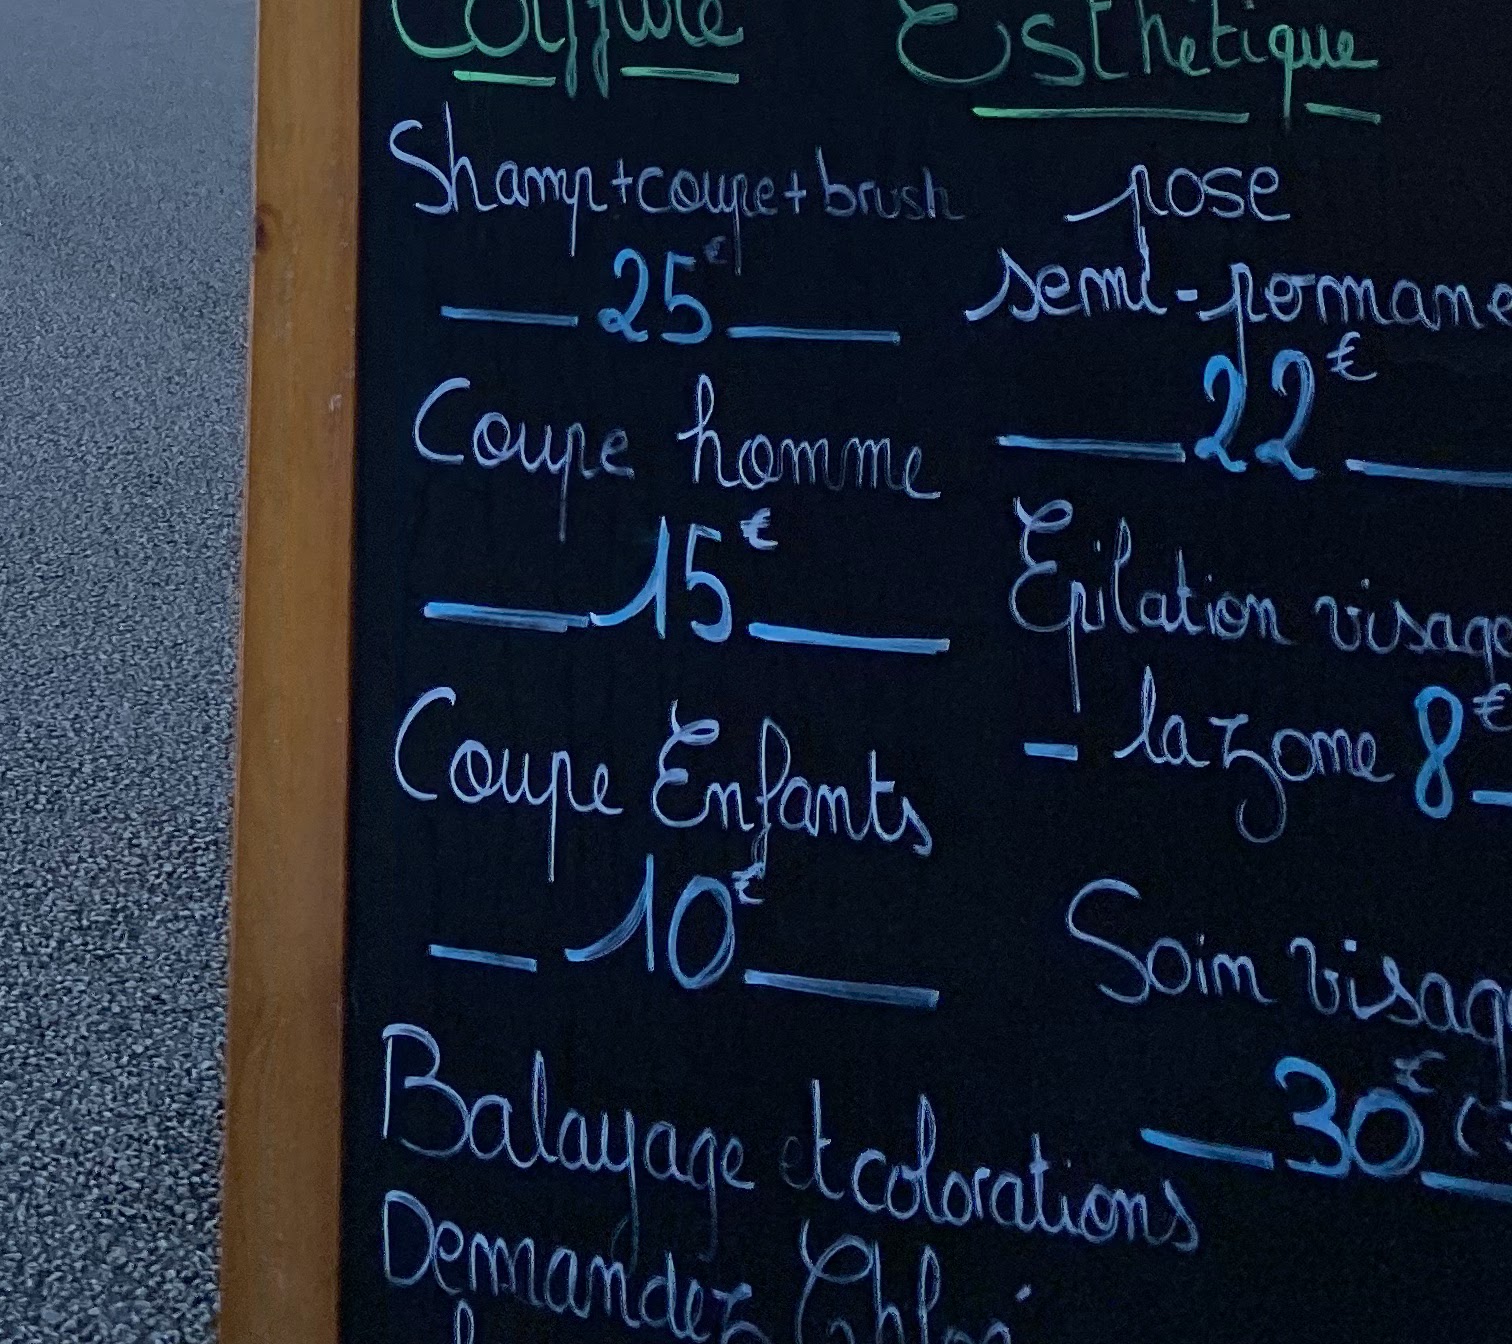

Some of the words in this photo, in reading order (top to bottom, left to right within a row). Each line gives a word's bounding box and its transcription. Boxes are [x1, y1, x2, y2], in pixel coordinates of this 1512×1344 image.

[1064, 165, 1291, 262] pose
[414, 377, 635, 543] Coupe
[678, 374, 941, 500] homme
[394, 686, 626, 883] Coupe
[653, 700, 934, 879] Enfants
[1113, 665, 1211, 766] la
[1208, 714, 1396, 844] zone
[1066, 877, 1276, 1004] Soin
[1290, 936, 1512, 1100] visag
[381, 1022, 755, 1267] Balayage
[779, 1079, 845, 1200] et
[850, 1093, 1199, 1253] colorations
[796, 1218, 1033, 1344] Chl
